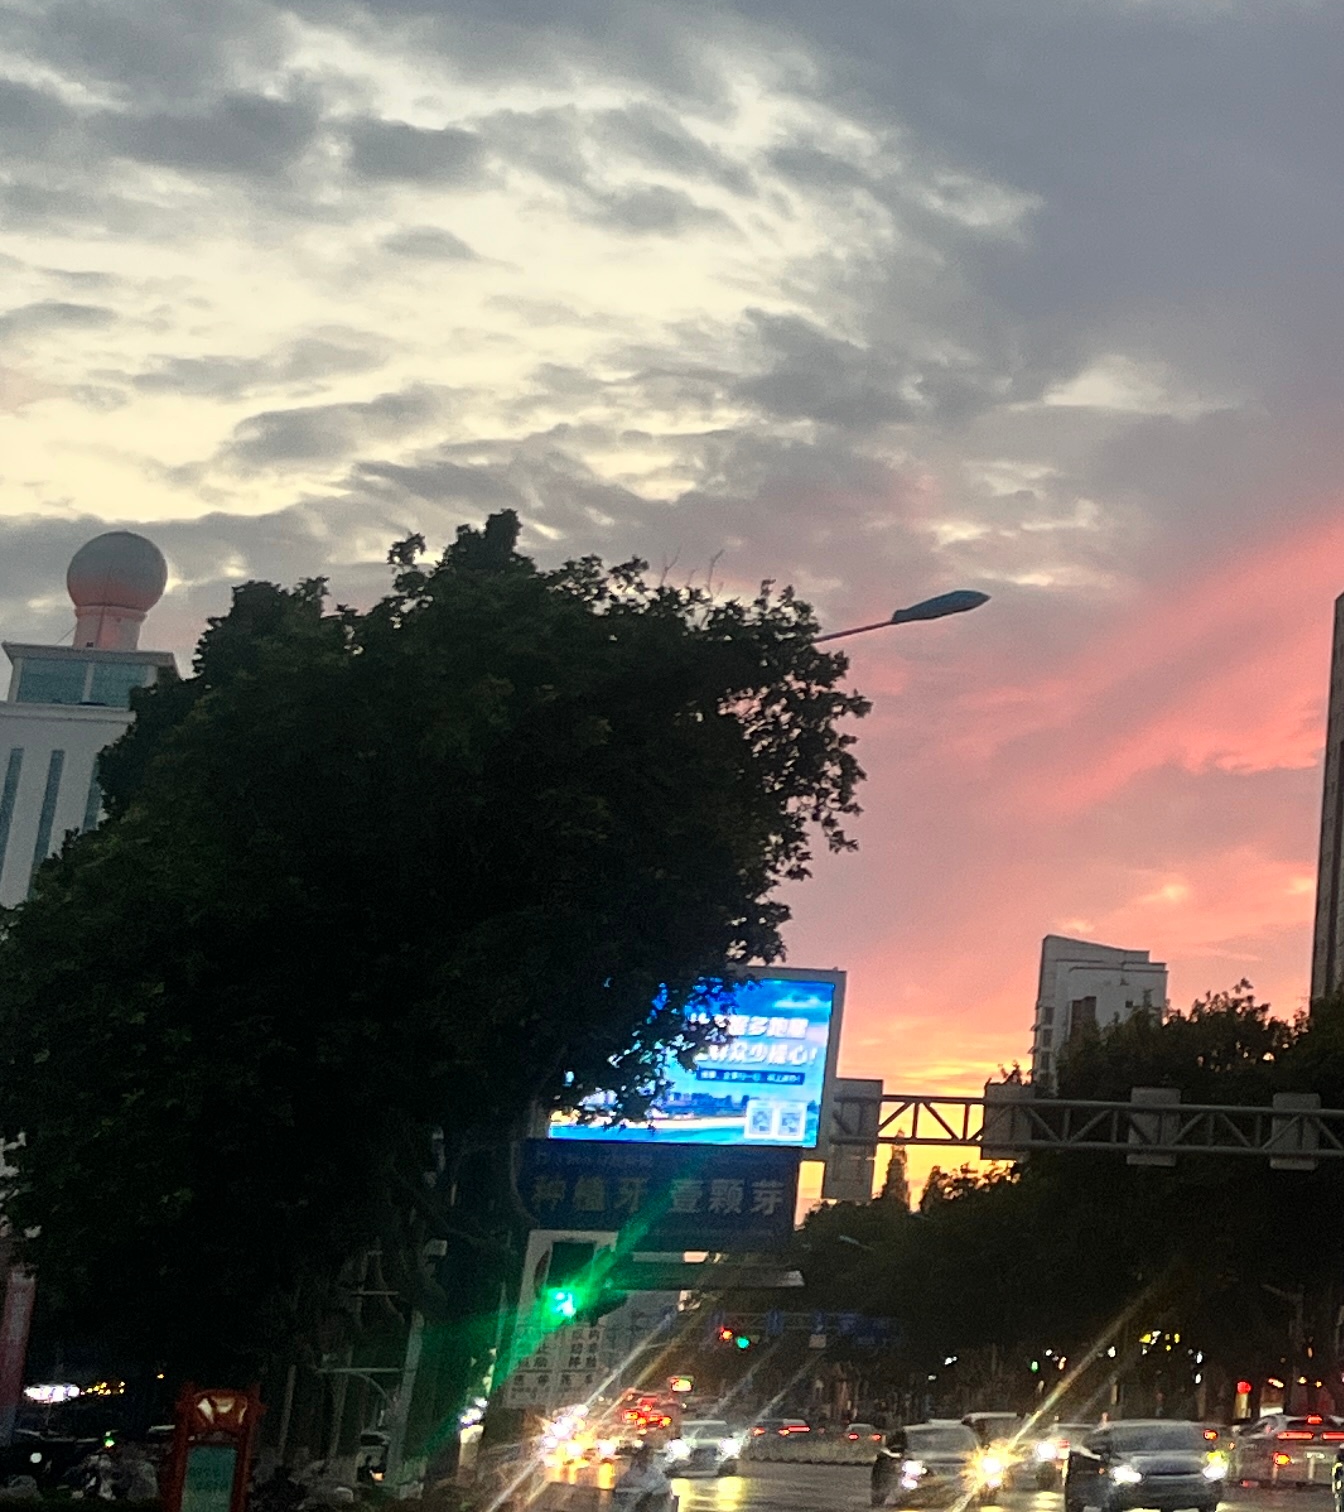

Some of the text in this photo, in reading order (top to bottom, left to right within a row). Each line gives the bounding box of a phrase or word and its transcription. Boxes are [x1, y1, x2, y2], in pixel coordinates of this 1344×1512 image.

[531, 1174, 785, 1216] 种植牙 壹颗芽
